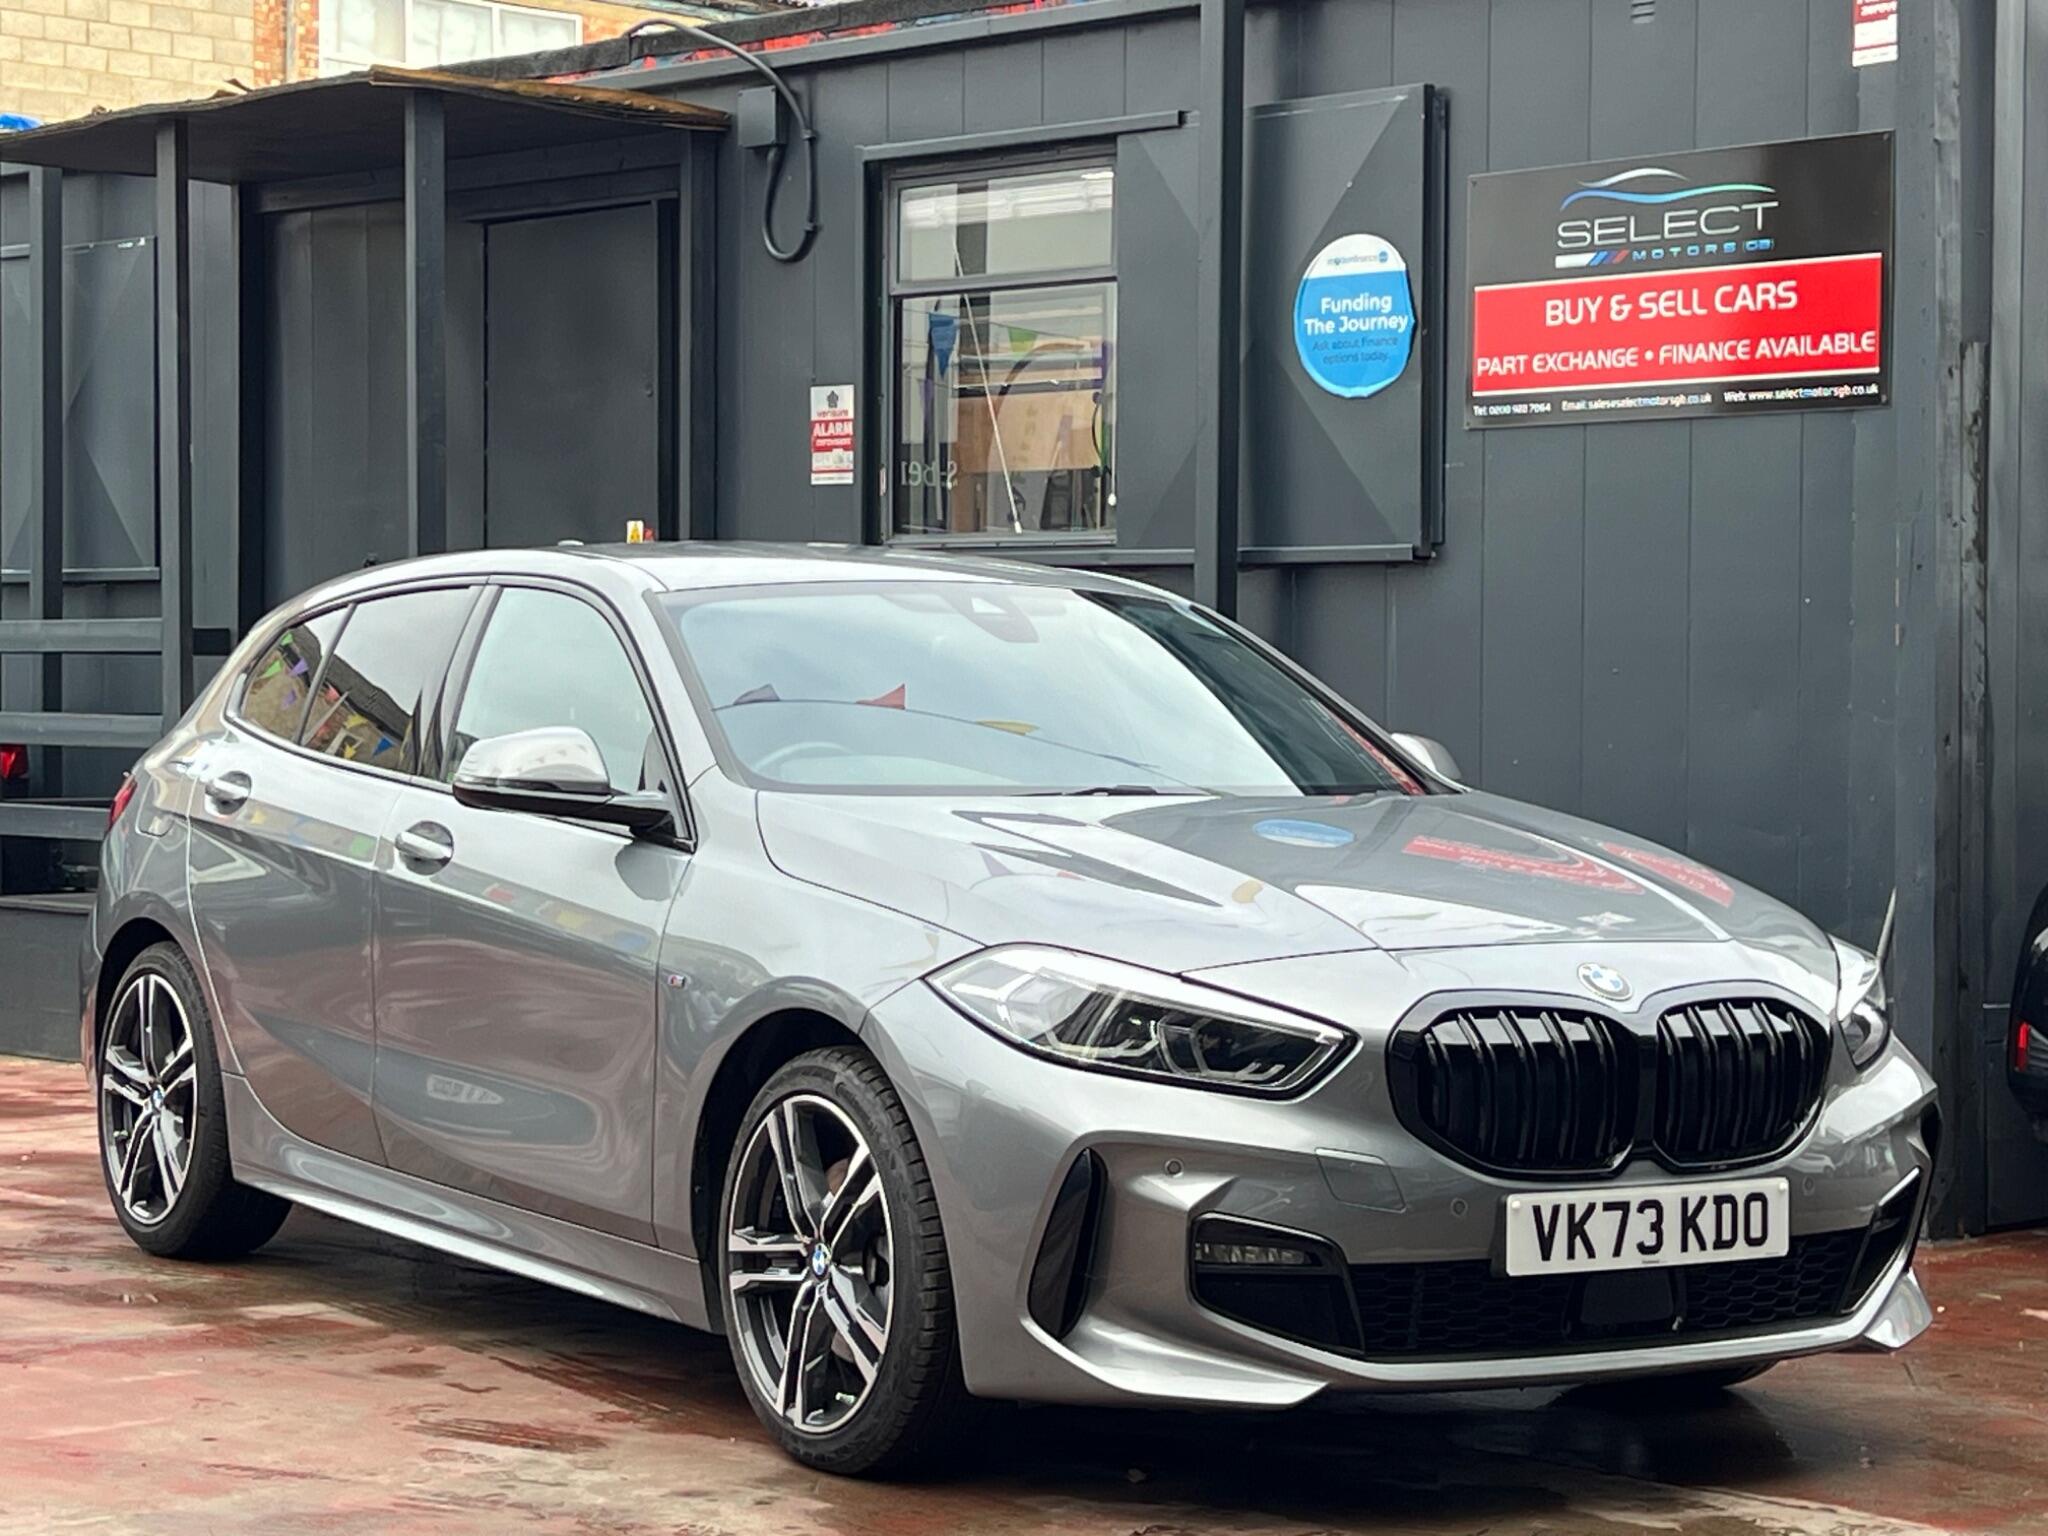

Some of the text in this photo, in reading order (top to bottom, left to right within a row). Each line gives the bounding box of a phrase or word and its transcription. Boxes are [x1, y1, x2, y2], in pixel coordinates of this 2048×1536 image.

[1557, 201, 1779, 248] SELECT
[1632, 241, 1737, 262] MOTORS
[1321, 292, 1393, 314] Funding
[1545, 281, 1799, 327] BUY & SELL CARS
[1304, 314, 1408, 336] The Journey
[1332, 338, 1360, 350] about
[1476, 330, 1876, 378] PART EXCHANGE FINANCE AVAILABLE
[812, 421, 854, 438] ALARM
[1532, 1192, 1769, 1262] VK73 KDO
